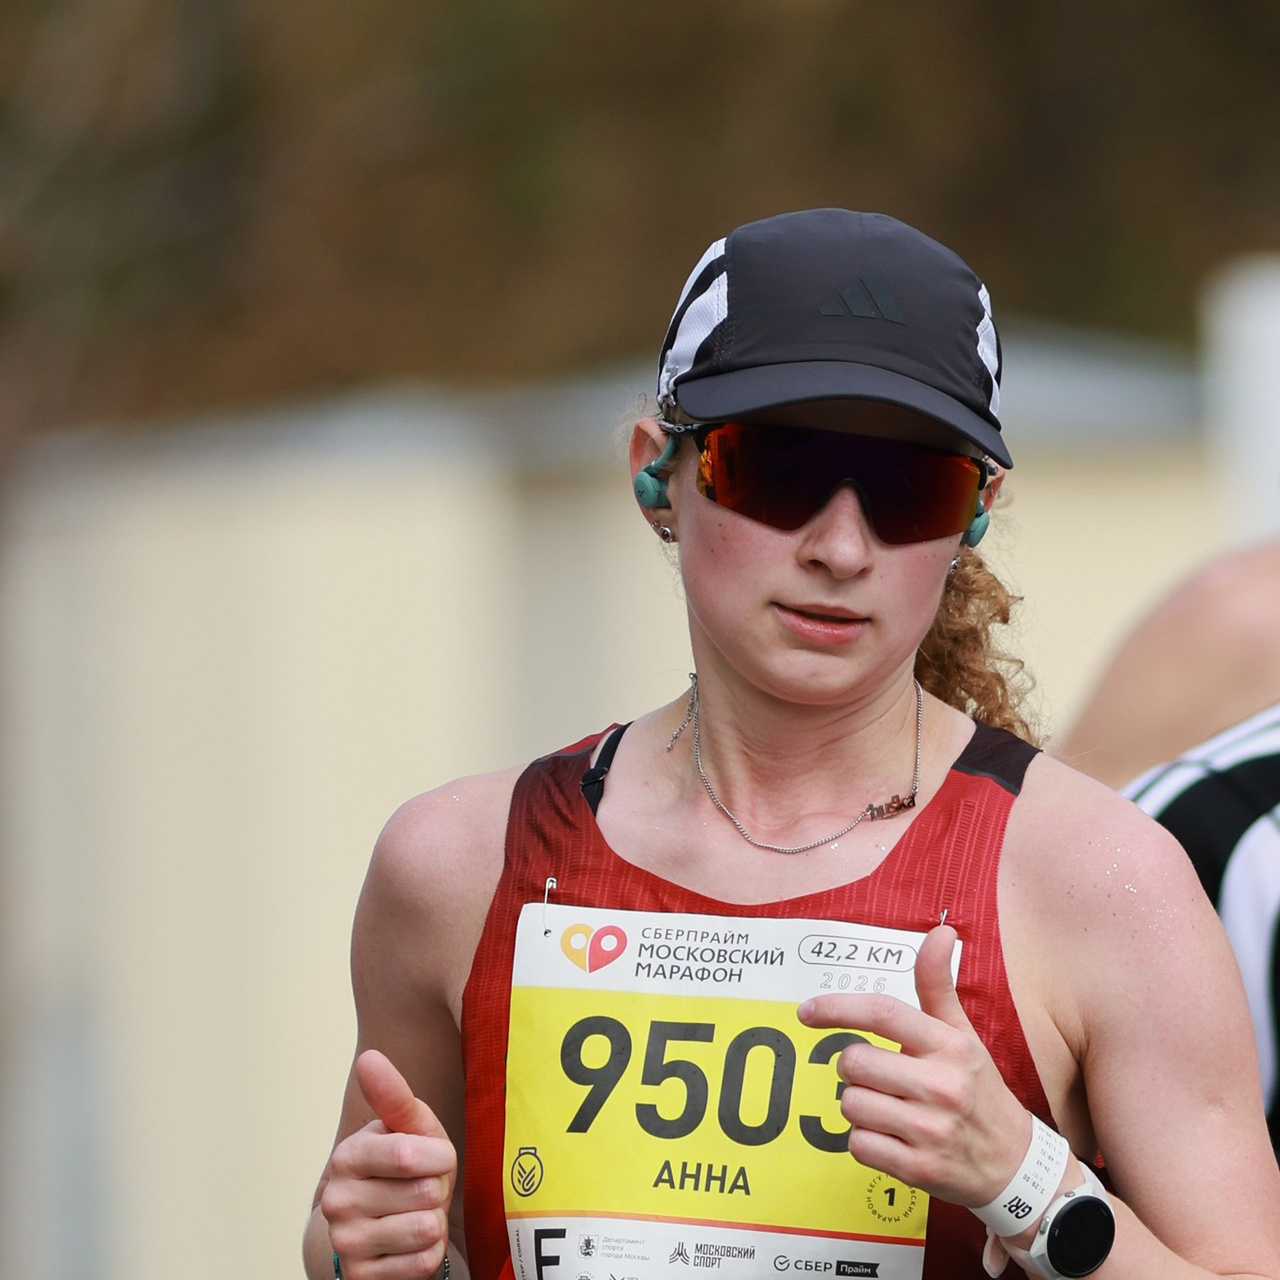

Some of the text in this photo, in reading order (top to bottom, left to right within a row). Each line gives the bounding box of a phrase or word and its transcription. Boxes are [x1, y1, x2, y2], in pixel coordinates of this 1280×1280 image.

[641, 927, 749, 945] СБЕРПРАЙМ
[638, 943, 785, 966] МОСКОВСКИЙ
[811, 942, 903, 965] 42,2 КМ
[635, 962, 743, 982] МАРАФОН
[820, 972, 887, 993] 2026
[653, 1160, 751, 1196] АННА
[883, 1187, 896, 1207] 1
[695, 1243, 755, 1260] МОСКОВСКИЙ
[693, 1255, 722, 1269] СПОРТ
[794, 1259, 872, 1275] СБЕР Прайм
